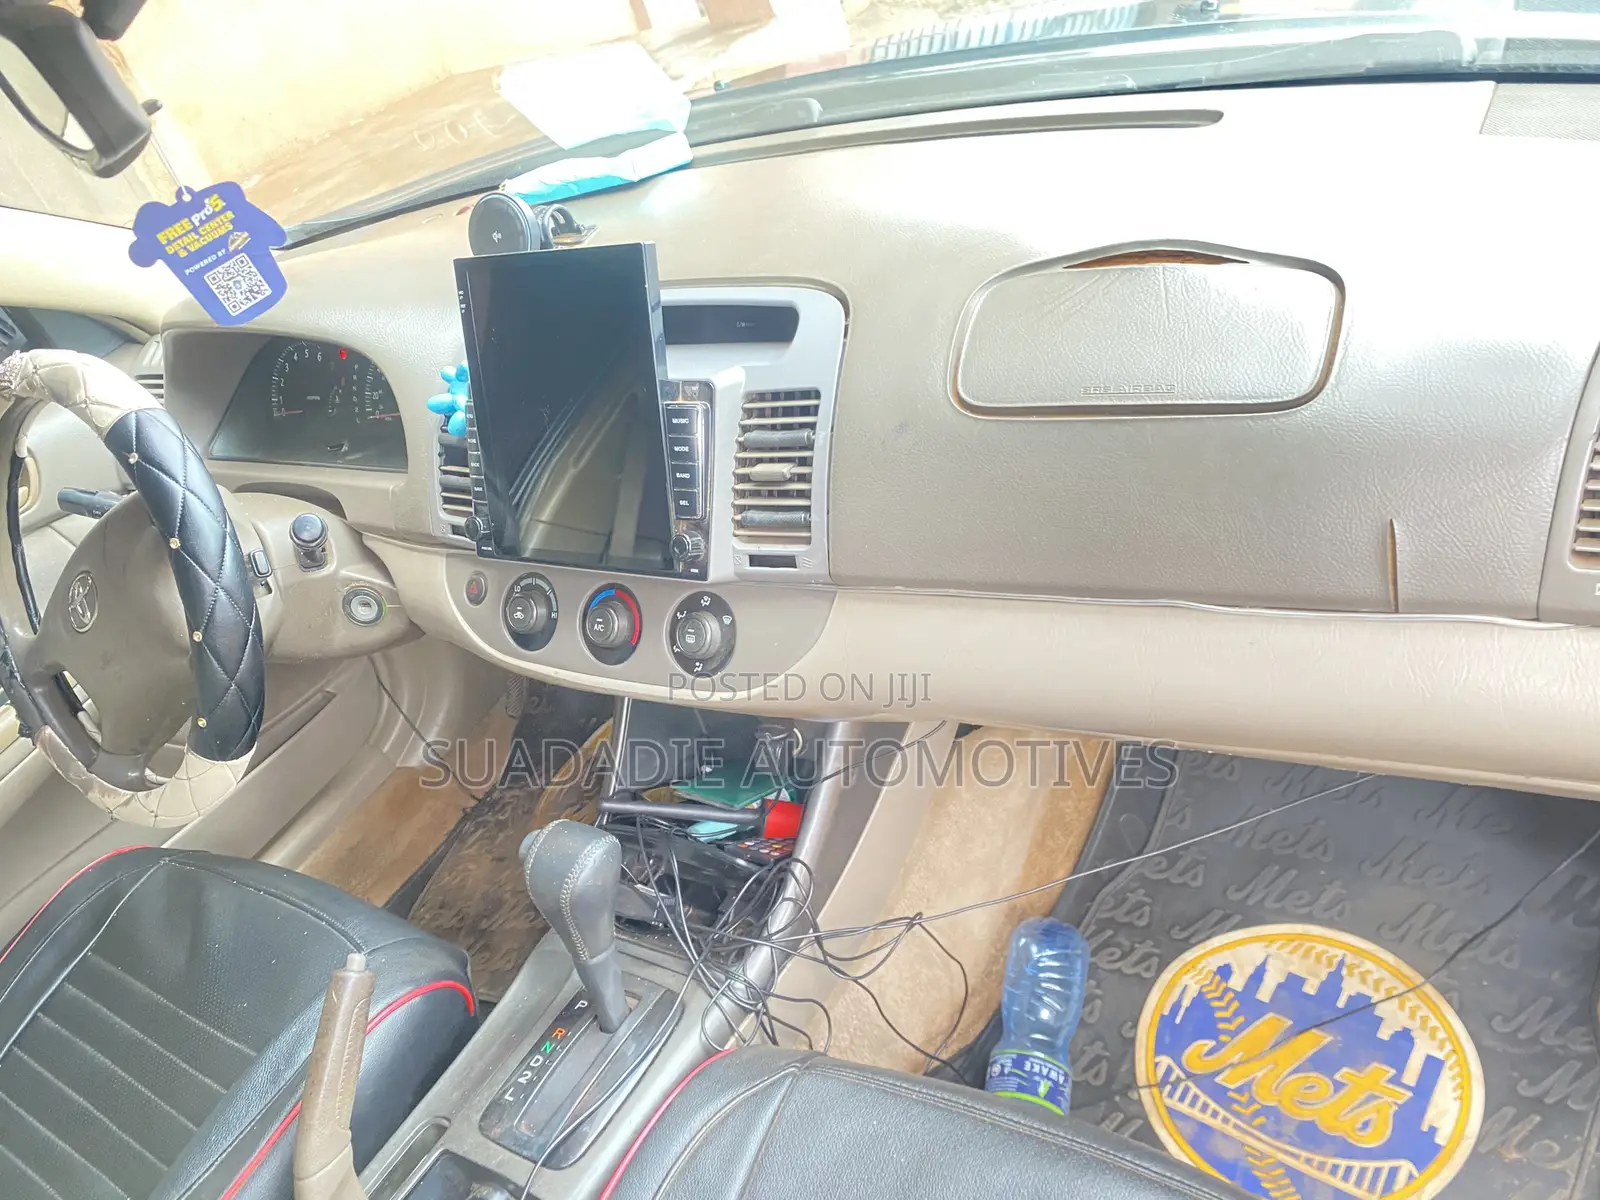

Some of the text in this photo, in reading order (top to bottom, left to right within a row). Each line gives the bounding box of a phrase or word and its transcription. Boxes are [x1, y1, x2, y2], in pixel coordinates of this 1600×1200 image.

[156, 217, 194, 245] FREE
[165, 210, 235, 255] DETAIL CENTER
[187, 222, 233, 252] VACUUMS
[184, 248, 227, 276] POWERED BY
[293, 353, 298, 361] 4
[304, 349, 309, 358] 5
[317, 352, 322, 361] 6
[1119, 384, 1176, 393] AIRBAG
[551, 611, 558, 619] HI
[593, 623, 604, 632] A/C
[1141, 847, 1207, 888] ets
[1225, 864, 1349, 921] Mets
[1376, 900, 1522, 970] Mets
[574, 1000, 588, 1010] P
[552, 1027, 566, 1039] R
[541, 1041, 555, 1054] N
[530, 1054, 544, 1067] D
[517, 1070, 533, 1084] 2
[1023, 1060, 1065, 1085] AWAKE
[1181, 1012, 1413, 1148] Mets
[504, 1087, 514, 1102] L
